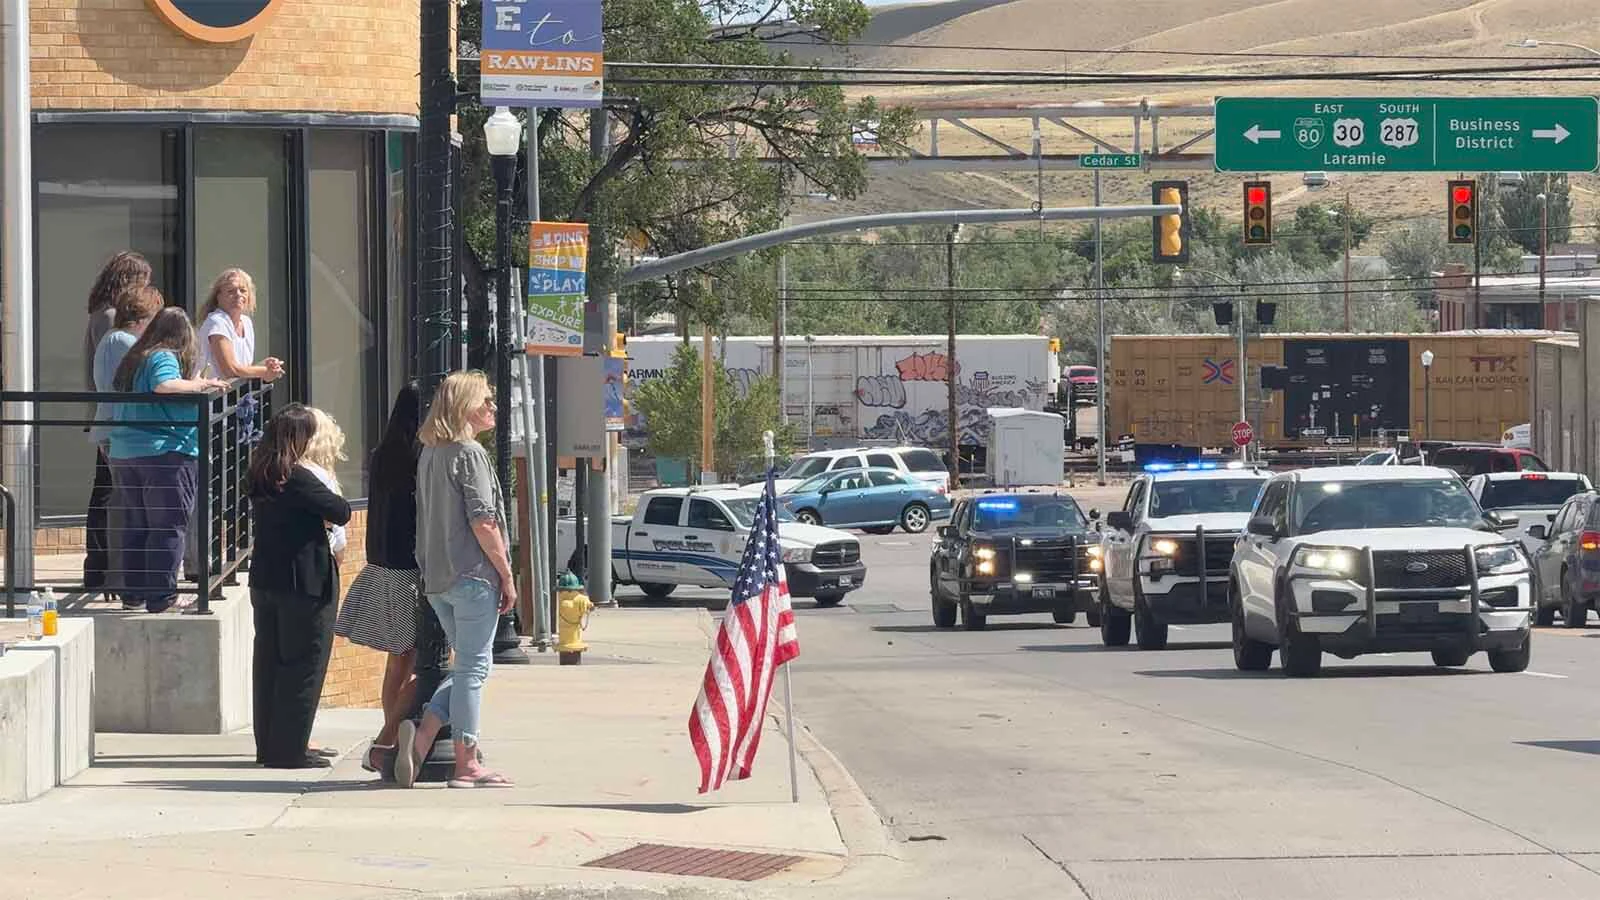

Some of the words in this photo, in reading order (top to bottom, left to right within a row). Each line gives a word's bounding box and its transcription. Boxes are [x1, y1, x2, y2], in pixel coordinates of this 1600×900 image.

[527, 12, 596, 46] to
[488, 54, 594, 71] RAWLINS
[1314, 103, 1345, 114] EAST
[1379, 103, 1420, 114] SOUTH
[1449, 117, 1521, 131] Business
[1299, 128, 1320, 143] 80
[1336, 124, 1361, 141] 30
[1383, 124, 1416, 141] 287
[1455, 135, 1514, 149] District
[1083, 155, 1119, 166] Cedar
[1124, 156, 1137, 166] St
[1323, 151, 1387, 165] Laramie
[554, 231, 584, 244] DINE
[536, 255, 567, 265] SHOP
[543, 277, 583, 292] PLAY
[530, 303, 582, 329] EXPLORE
[628, 368, 664, 379] ARMN
[1233, 428, 1252, 440] STOP
